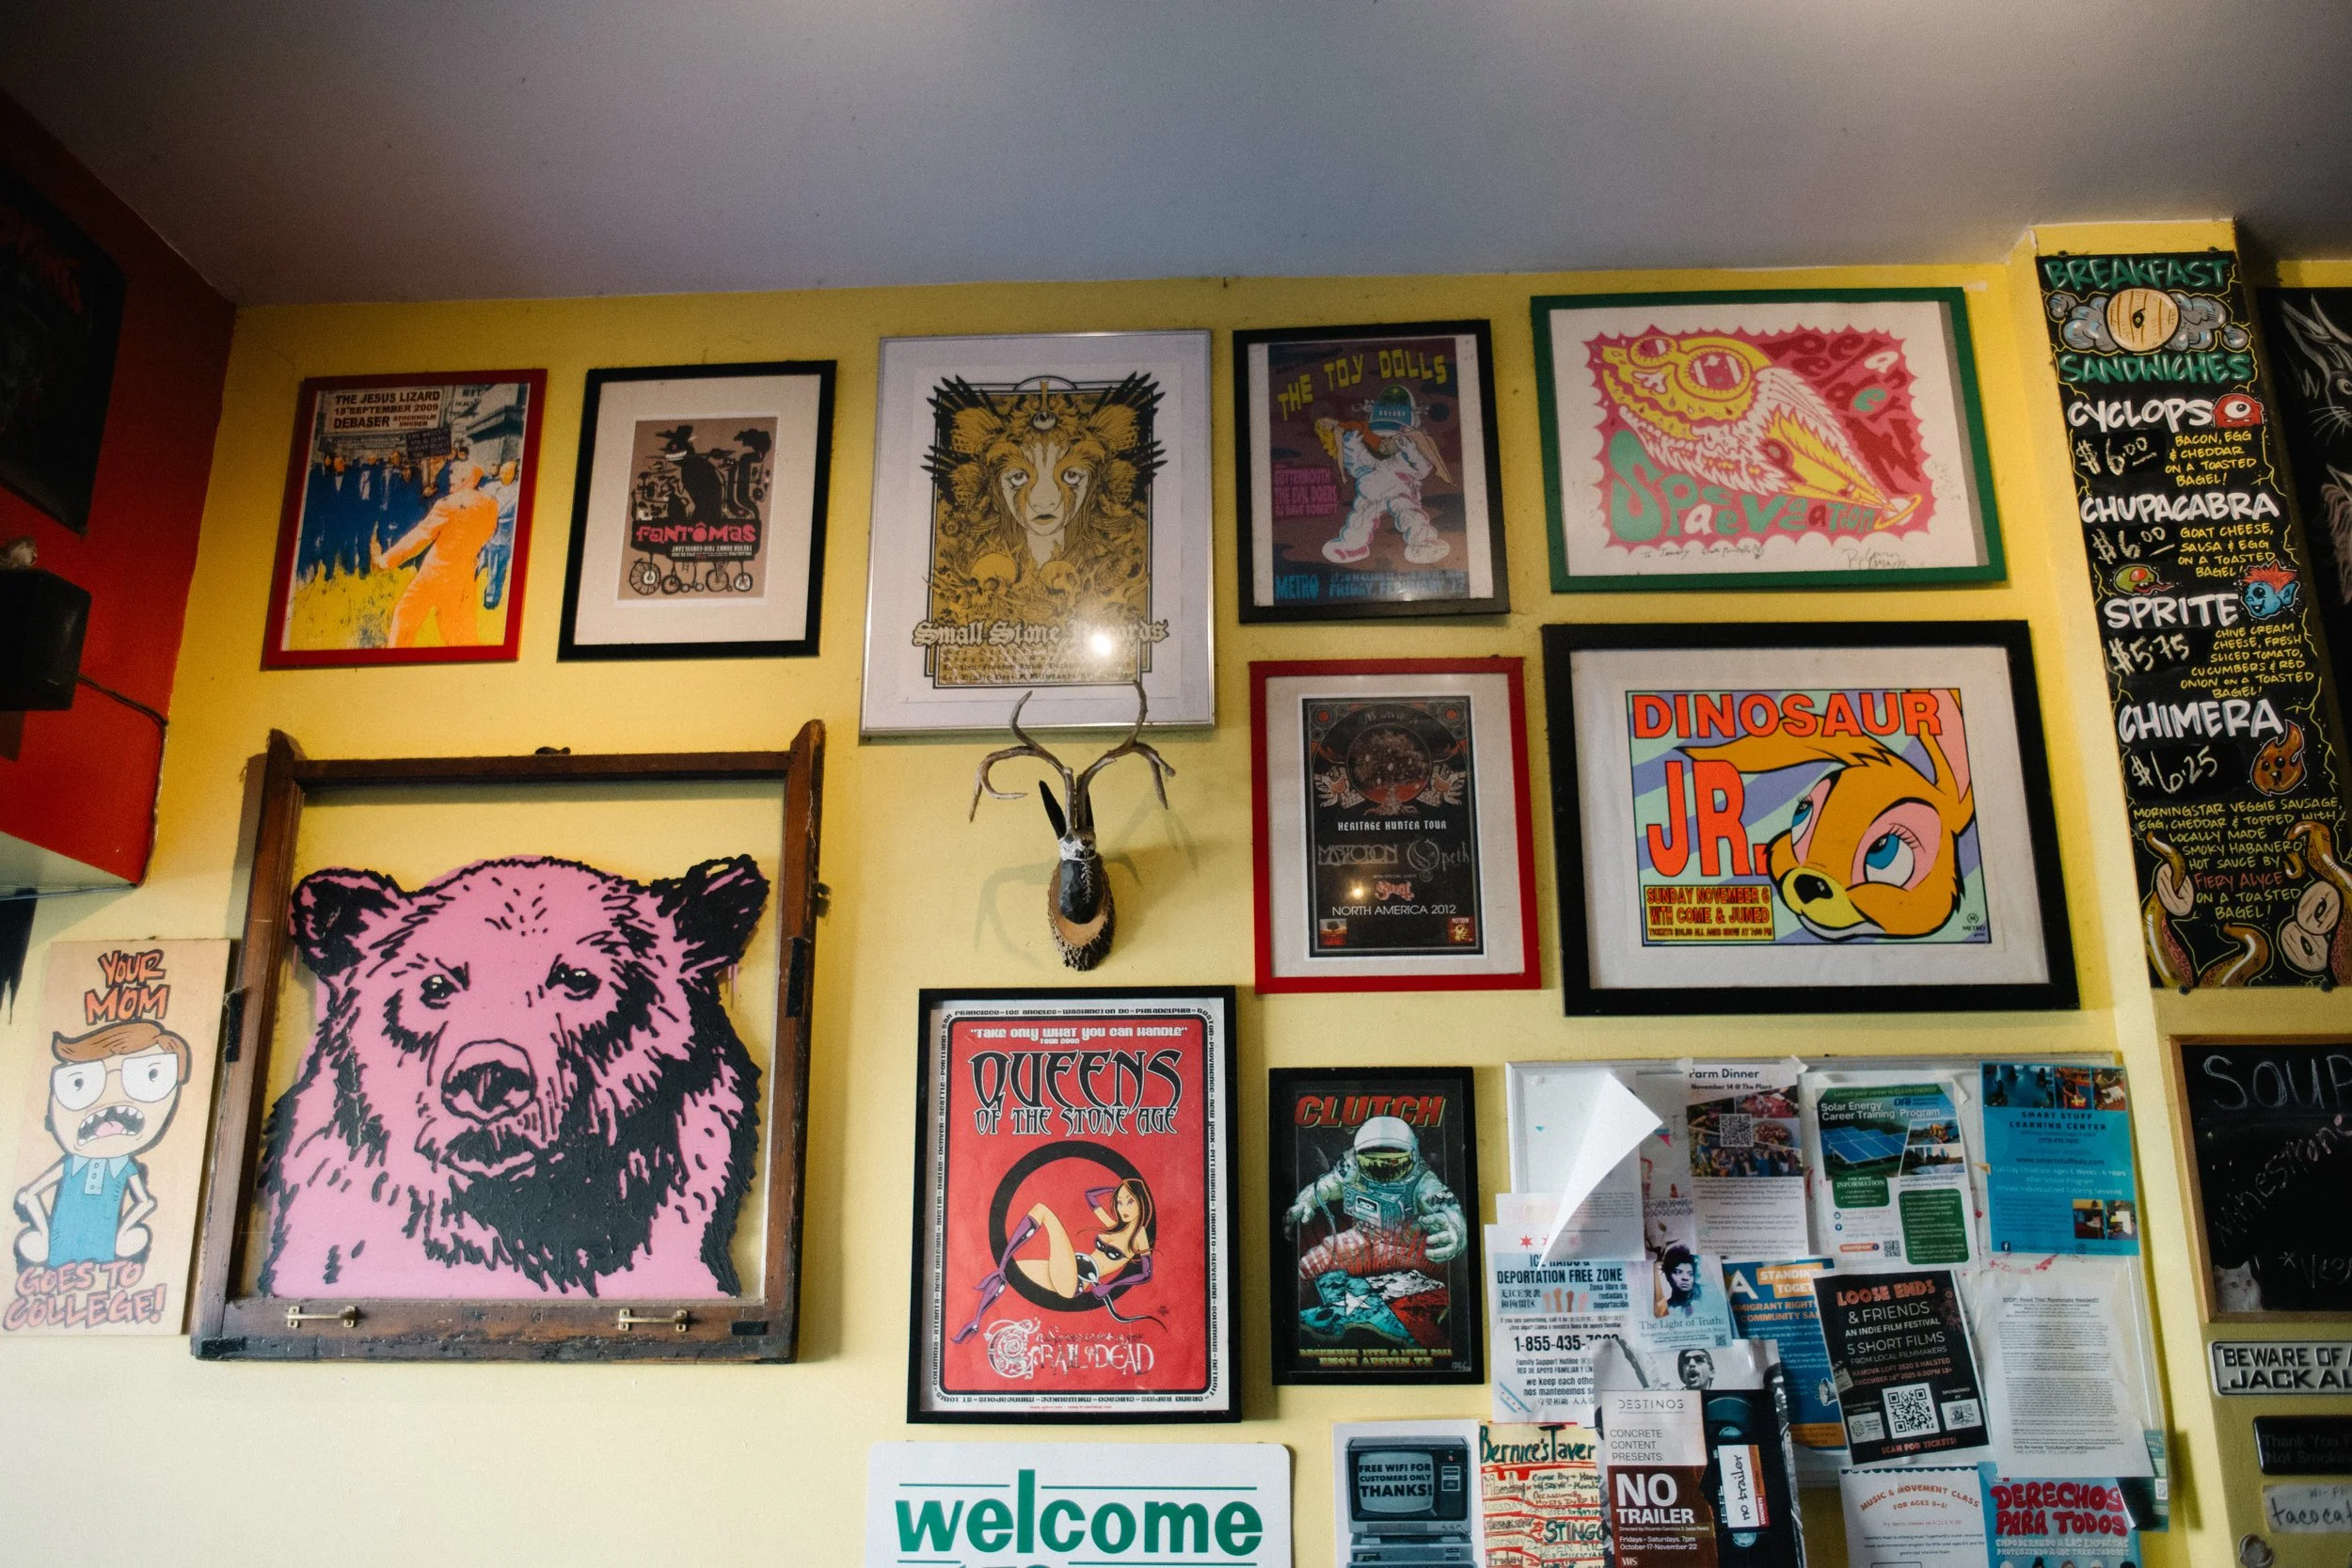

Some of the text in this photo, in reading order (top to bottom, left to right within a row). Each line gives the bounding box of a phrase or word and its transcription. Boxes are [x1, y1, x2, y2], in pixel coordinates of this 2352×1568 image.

[2043, 258, 2232, 290] BREAKFAST
[2058, 353, 2252, 385] SANDWICHES
[1277, 349, 1447, 421] THE TOY DOLLS
[336, 390, 440, 404] THE JESUS LIZARD
[349, 405, 411, 415] SEPTEMBER
[414, 404, 438, 412] 2009
[2068, 399, 2214, 434] CYCLOPS
[333, 417, 390, 429] DEBASER
[2175, 431, 2252, 448] BACON, EGG
[2180, 446, 2245, 460] CHEDDAR
[2165, 458, 2257, 474] ON A TOASTED
[2176, 472, 2228, 487] BAGEL!
[2079, 491, 2280, 524] CHUPACABRA
[2180, 523, 2274, 539] GOAT CHEESE,
[2180, 538, 2269, 553] SALSA EGG
[2178, 549, 2276, 565] ON TOASTED
[2196, 565, 2244, 578] BAGEL!
[2104, 594, 2239, 629] SPRITE
[2215, 623, 2295, 639] CHIVE CREAM
[2213, 635, 2301, 651] CHEESE, FRESH
[2210, 648, 2303, 663] SLICED TOMATO,
[2191, 659, 2305, 676] CUCUMBERS RED
[2180, 677, 2217, 689] ONION
[2255, 671, 2314, 684] TOASTED
[2212, 687, 2263, 699] BAGEL!
[1632, 691, 1942, 738] DINOSAUR
[2119, 699, 2284, 743] CHIMERA
[2133, 798, 2342, 819] MORNINGSTAR VEGGIE SAUSAGE,
[1338, 820, 1381, 832] HERITAGE
[1423, 819, 1447, 830] TOUR
[1645, 759, 1769, 878] JR.
[2138, 819, 2169, 832] EGG,
[2171, 817, 2227, 830] CHEDDAR
[2243, 814, 2295, 826] TOPPED
[2169, 828, 2266, 843] LOCALLY MADE
[2182, 841, 2303, 857] SMOKY HABANERO
[2189, 855, 2280, 870] HOT SAUCE BY
[2194, 872, 2233, 892] FIERY
[1646, 887, 1770, 904] SUNDAY NOVEMBER 6
[2197, 888, 2302, 904] ON TOASTED
[1332, 904, 1457, 916] NORTH AMERICA 2012
[1677, 907, 1712, 924] COME
[1728, 907, 1770, 924] JUNED
[2216, 905, 2271, 920] BAGEL!
[98, 949, 167, 988] YOUR
[84, 984, 170, 1025] MOM
[968, 1049, 1184, 1114] QUEENS
[1722, 1069, 1759, 1079] Dinner
[1294, 1095, 1446, 1128] CLUTCH
[1820, 1101, 1883, 1114] Solar Energy
[1821, 1108, 1941, 1121] Career Training Program
[974, 1106, 1179, 1137] OF THE STONE AGE
[16, 1261, 146, 1297] GOES TO
[1497, 1268, 1623, 1284] DEPORTATION FREE ZONE
[1836, 1279, 1936, 1307] LOOSE ENDS
[3, 1283, 167, 1333] COLLEGE!
[1848, 1301, 1931, 1324] & FRIENDS
[1660, 1319, 1683, 1331] Light
[1845, 1318, 1941, 1338] AN INDIE FILM FESTIVAL
[1847, 1331, 1946, 1354] 5 SHORT FILMS
[2223, 1347, 2344, 1367] BEWARE OF
[1538, 1377, 1576, 1387] keep each
[1618, 1399, 1684, 1409] DESTINOS
[1610, 1429, 1662, 1438] CONCRETE
[1611, 1441, 1656, 1449] CONTENT
[1359, 1464, 1431, 1473] FREE WIFI FOR
[1359, 1474, 1407, 1482] CUSTOMERS
[1360, 1483, 1433, 1497] THANKS!
[1615, 1473, 1678, 1508] NO
[1860, 1484, 1979, 1511] MUSIC MOVEMENT CLASS
[1990, 1481, 2124, 1513] DERECHOS
[895, 1468, 1263, 1557] welcome
[1615, 1508, 1695, 1524] TRAILER
[1995, 1510, 2128, 1537] PARA TODOS
